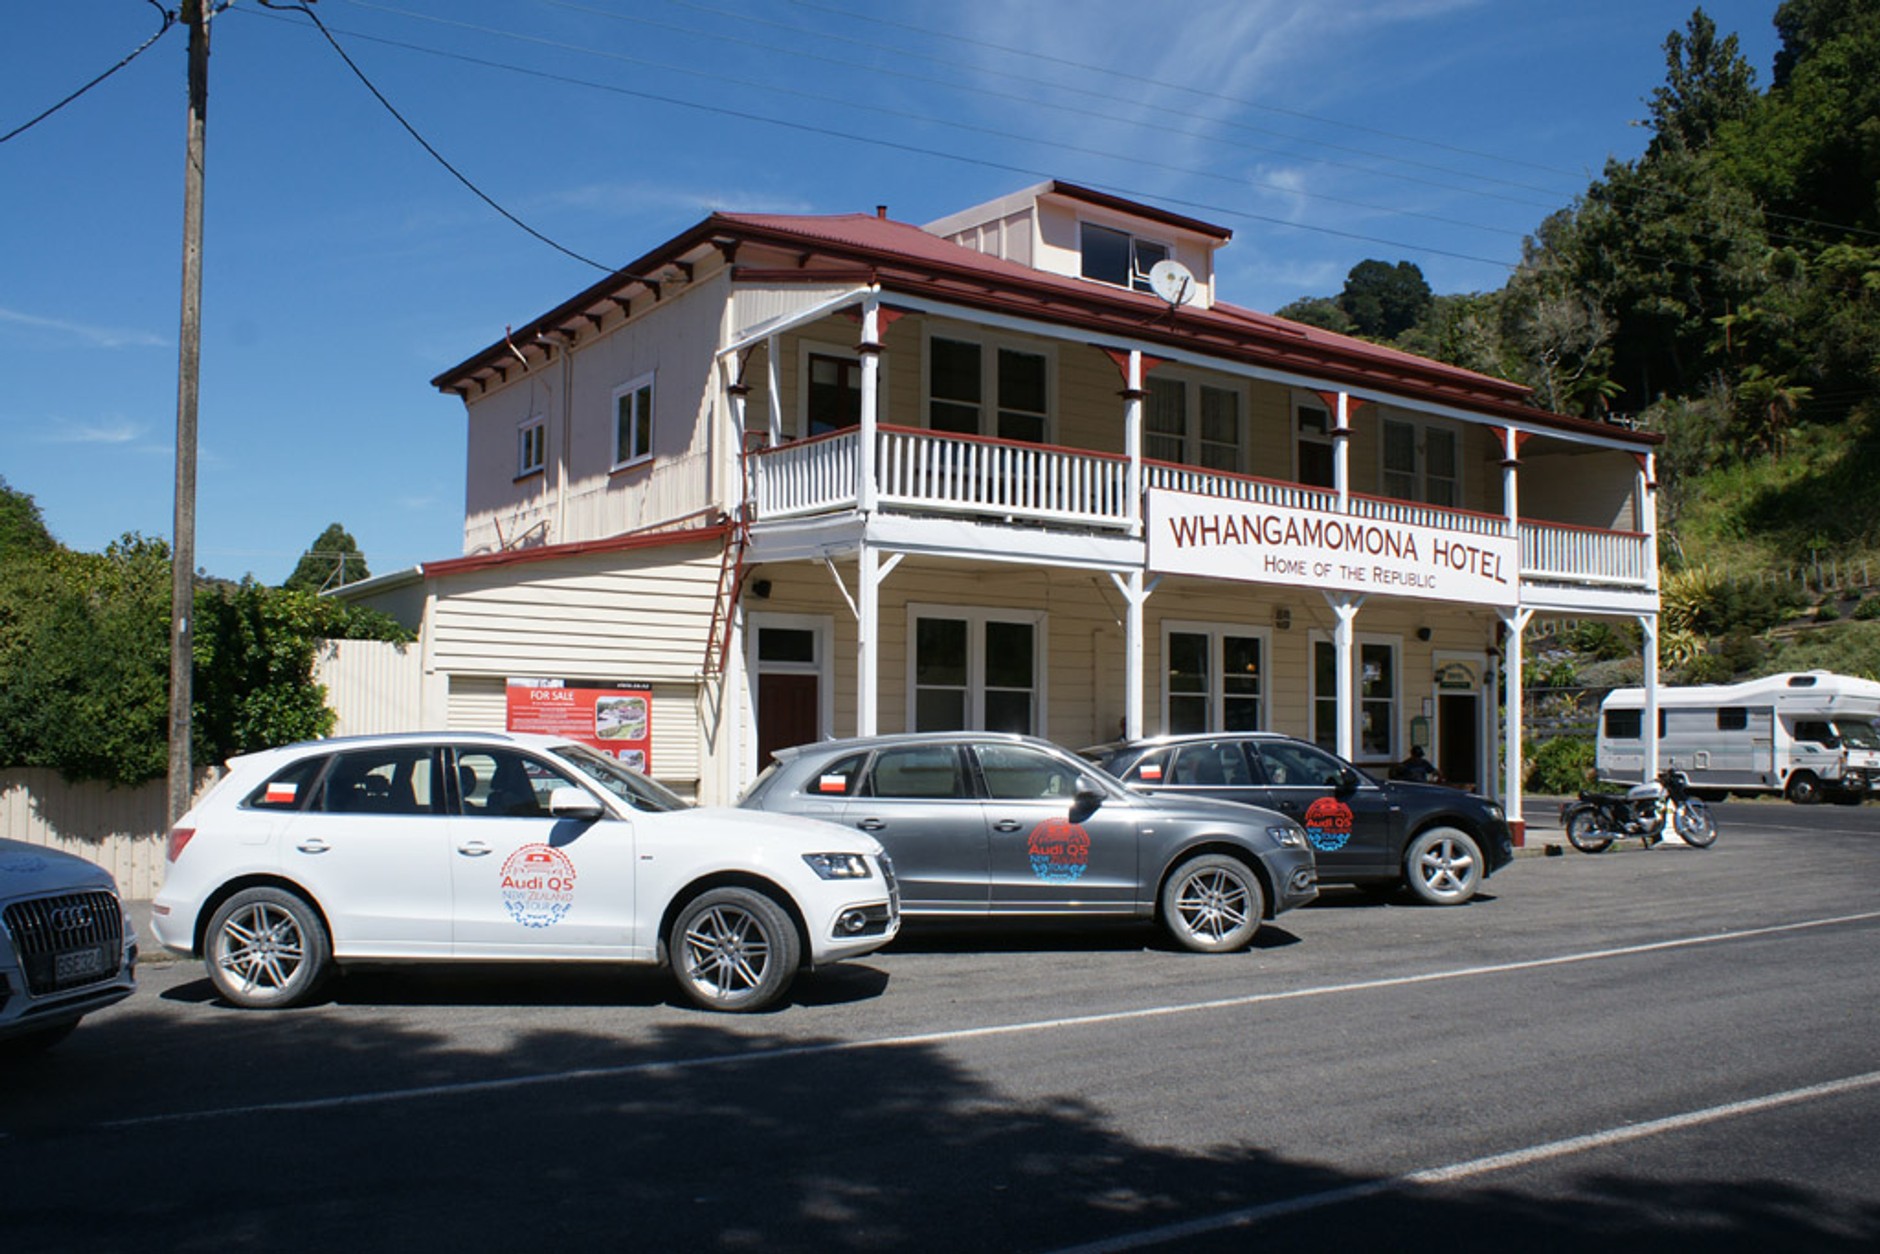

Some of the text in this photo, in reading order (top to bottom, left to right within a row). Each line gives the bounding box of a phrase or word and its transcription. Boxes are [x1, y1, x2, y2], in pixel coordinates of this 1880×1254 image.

[1169, 515, 1508, 585] WHANGAMOMONA HOTEL
[1313, 562, 1332, 578] OF
[1339, 565, 1366, 581] THE
[530, 690, 574, 701] FOR SALE
[1307, 818, 1333, 827] Audi
[1028, 844, 1089, 857] Audi Q5
[501, 875, 574, 892] Audi Q5
[502, 890, 574, 902] NEW ZEALAND
[524, 902, 550, 910] TOUR
